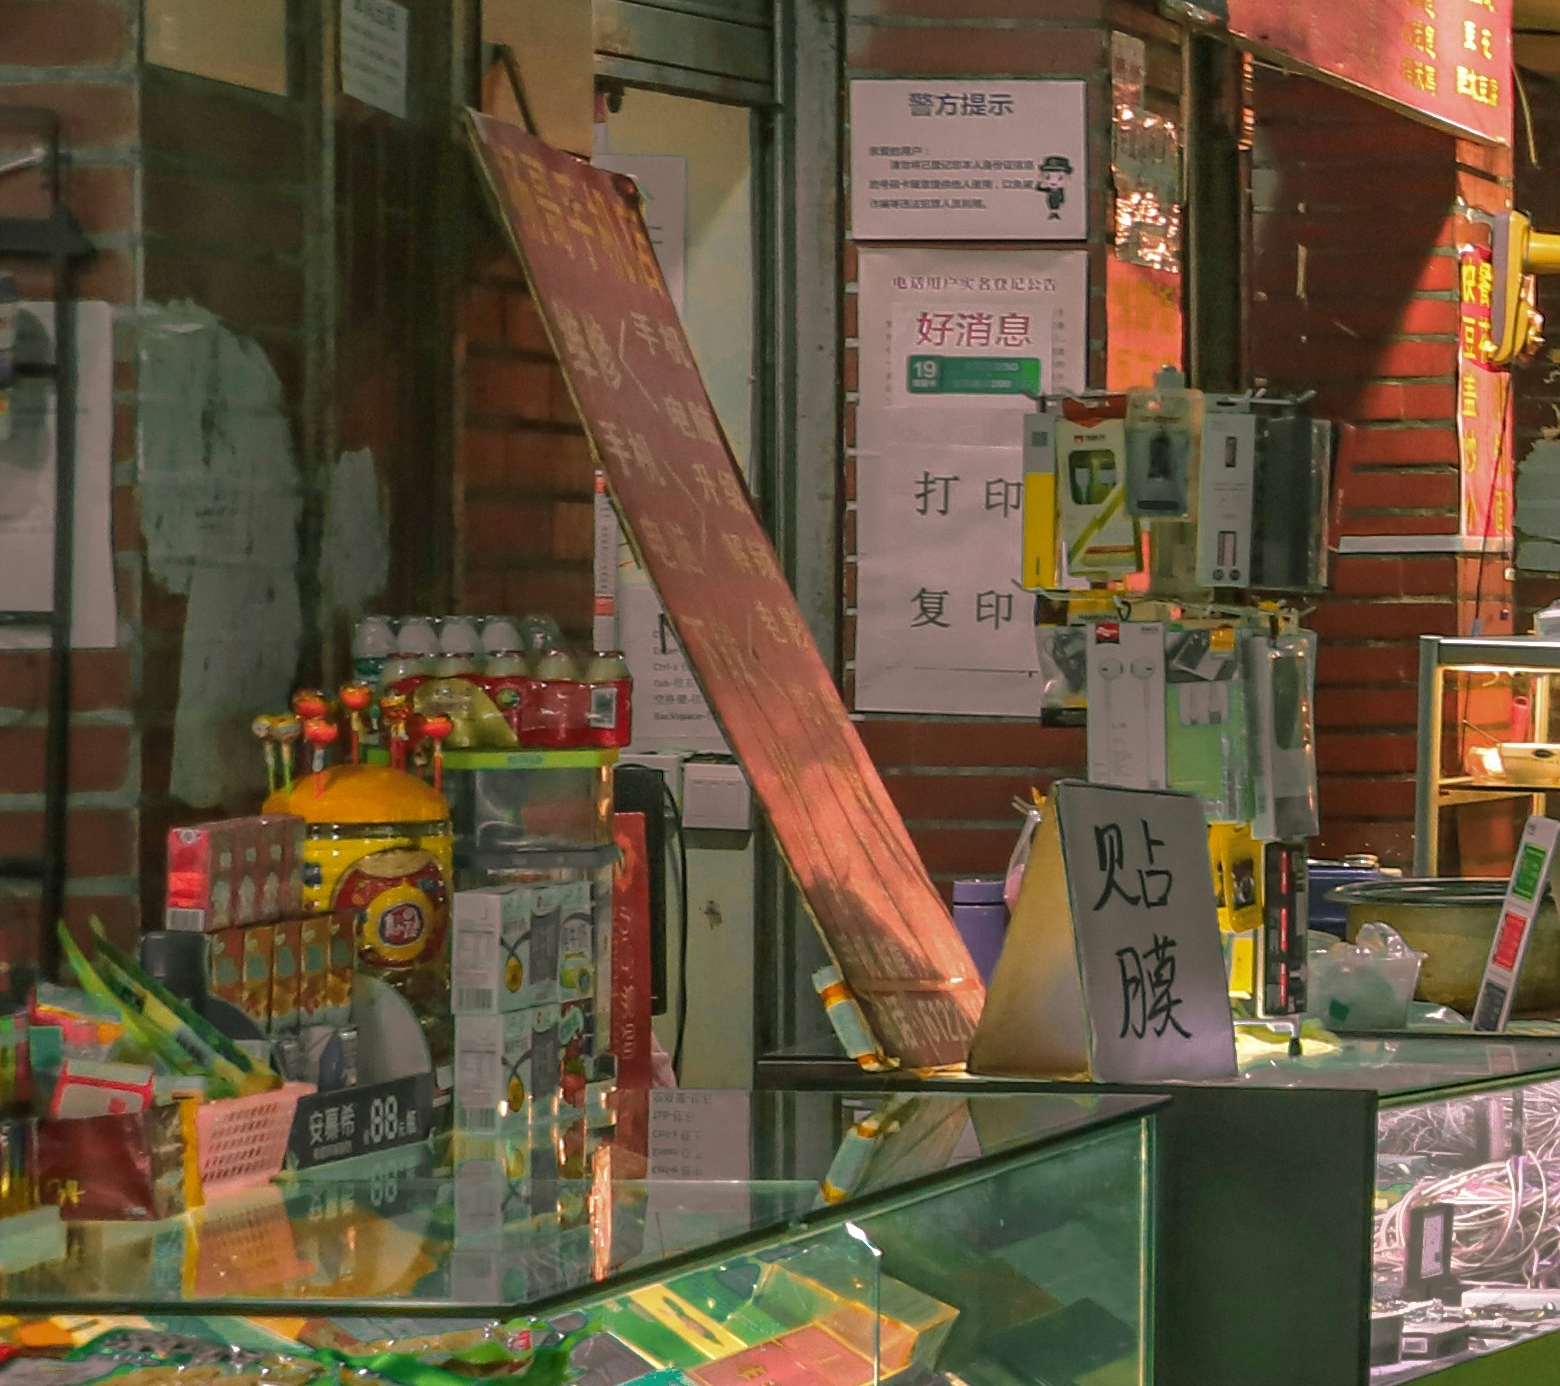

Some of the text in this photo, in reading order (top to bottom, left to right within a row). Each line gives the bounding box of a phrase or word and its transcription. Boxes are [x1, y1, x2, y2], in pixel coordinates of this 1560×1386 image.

[908, 92, 1014, 116] 警方提示
[893, 275, 1056, 292] 电话用户实名登记公告
[916, 312, 1032, 347] 好消息
[912, 360, 939, 379] 19
[914, 470, 1024, 518] 打印
[910, 587, 1014, 631] 复印
[1093, 818, 1194, 1039] 贴膜
[308, 1102, 356, 1146] 安慕希
